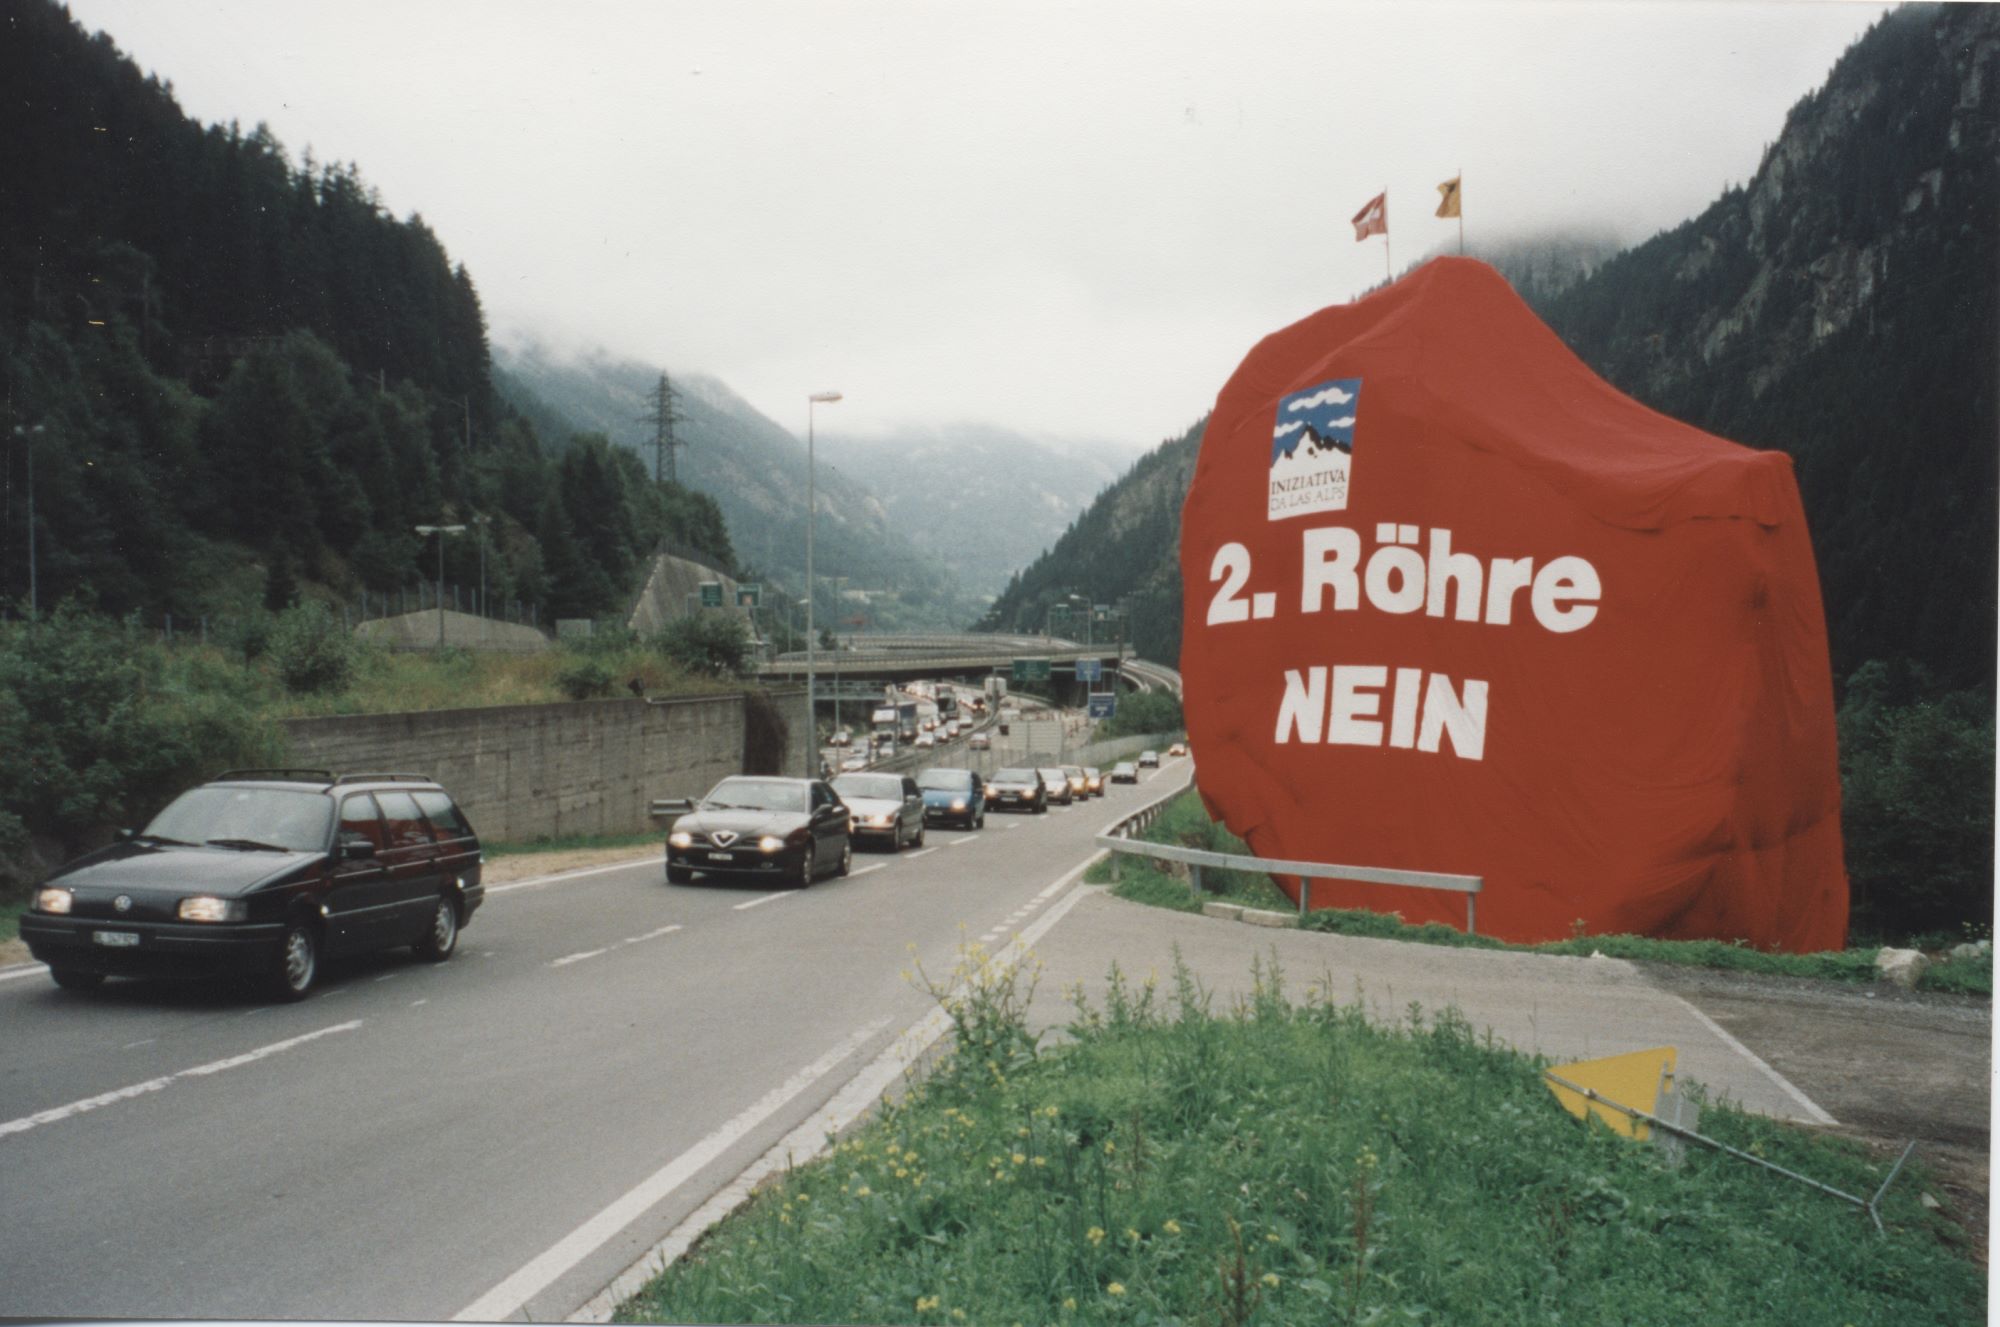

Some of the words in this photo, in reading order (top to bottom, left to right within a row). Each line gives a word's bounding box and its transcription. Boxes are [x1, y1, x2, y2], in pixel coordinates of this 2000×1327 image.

[1271, 469, 1346, 495] INIZIATIVA
[1271, 498, 1287, 511] DA
[1289, 493, 1311, 508] LAS
[1313, 487, 1345, 503] ALPS
[1206, 542, 1277, 626] 2.
[1300, 522, 1602, 634] Röhre
[1274, 665, 1489, 761] NEIN
